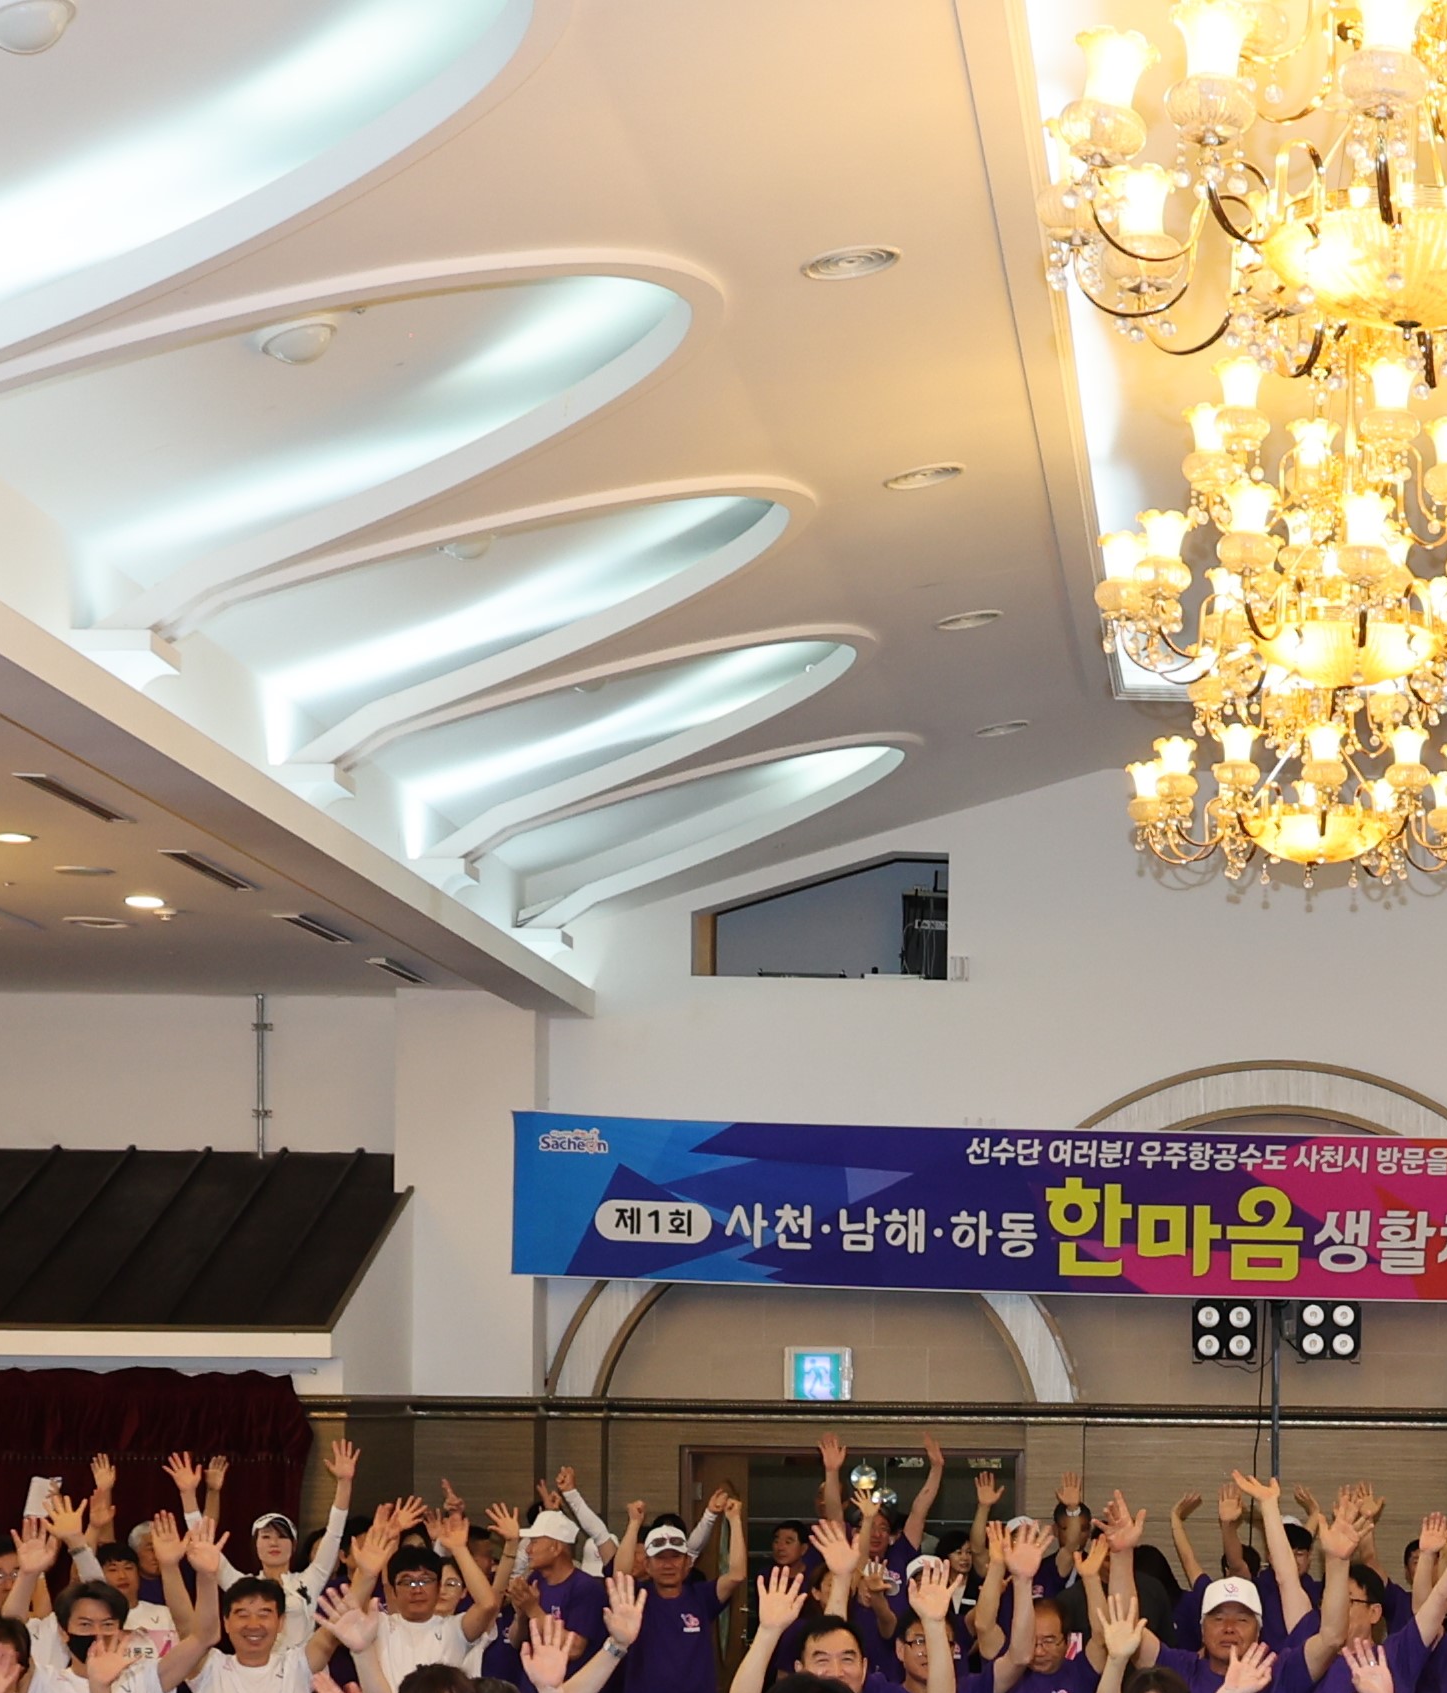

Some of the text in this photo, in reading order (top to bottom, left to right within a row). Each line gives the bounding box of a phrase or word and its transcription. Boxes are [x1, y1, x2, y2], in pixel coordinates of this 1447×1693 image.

[966, 1137, 1042, 1165] 선수단
[1048, 1140, 1133, 1168] 여러분!
[1137, 1141, 1288, 1171] 우주항공수도
[1293, 1145, 1368, 1173] 사천시
[614, 1206, 693, 1237] 제1회
[1046, 1177, 1303, 1282] 한마음
